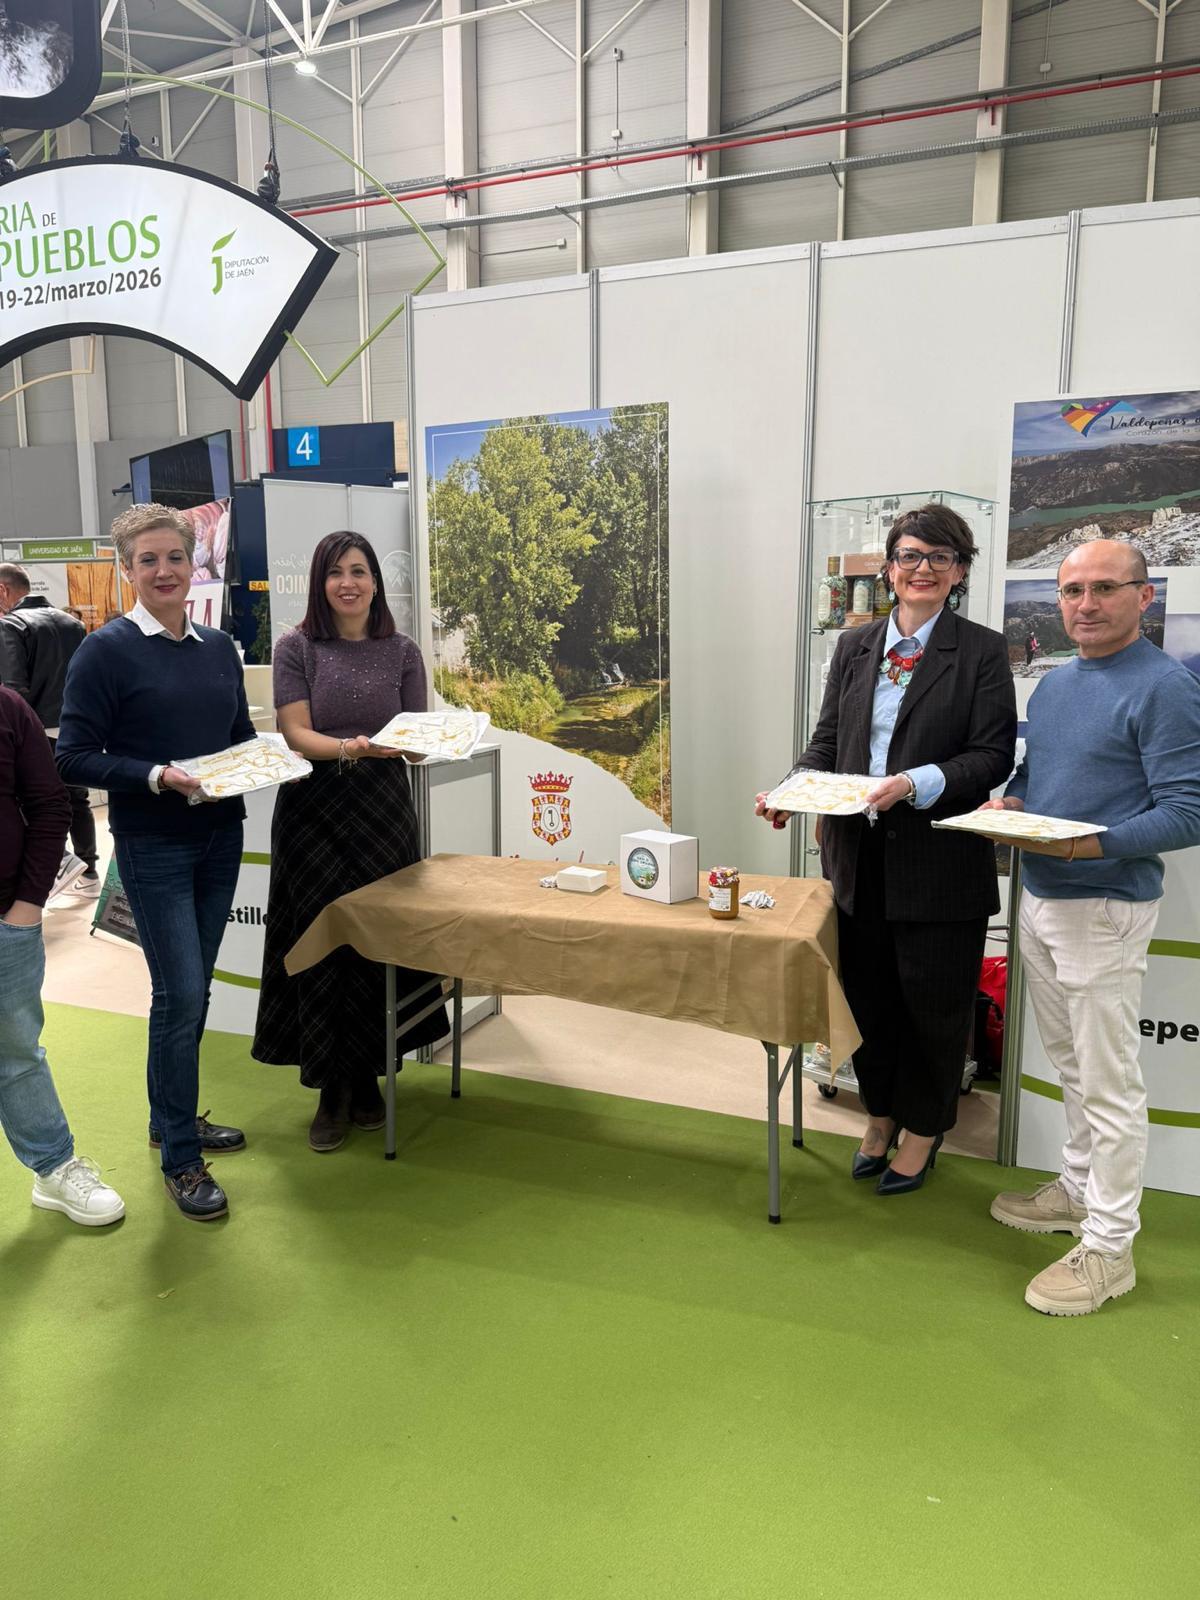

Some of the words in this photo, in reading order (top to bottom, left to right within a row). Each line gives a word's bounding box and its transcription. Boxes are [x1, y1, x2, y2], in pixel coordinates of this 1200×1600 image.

[42, 212, 57, 227] DE
[0, 214, 161, 282] PUEBLOS
[0, 267, 162, 310] 19-22/marzo/2026
[225, 271, 235, 279] DE
[296, 431, 313, 461] 4
